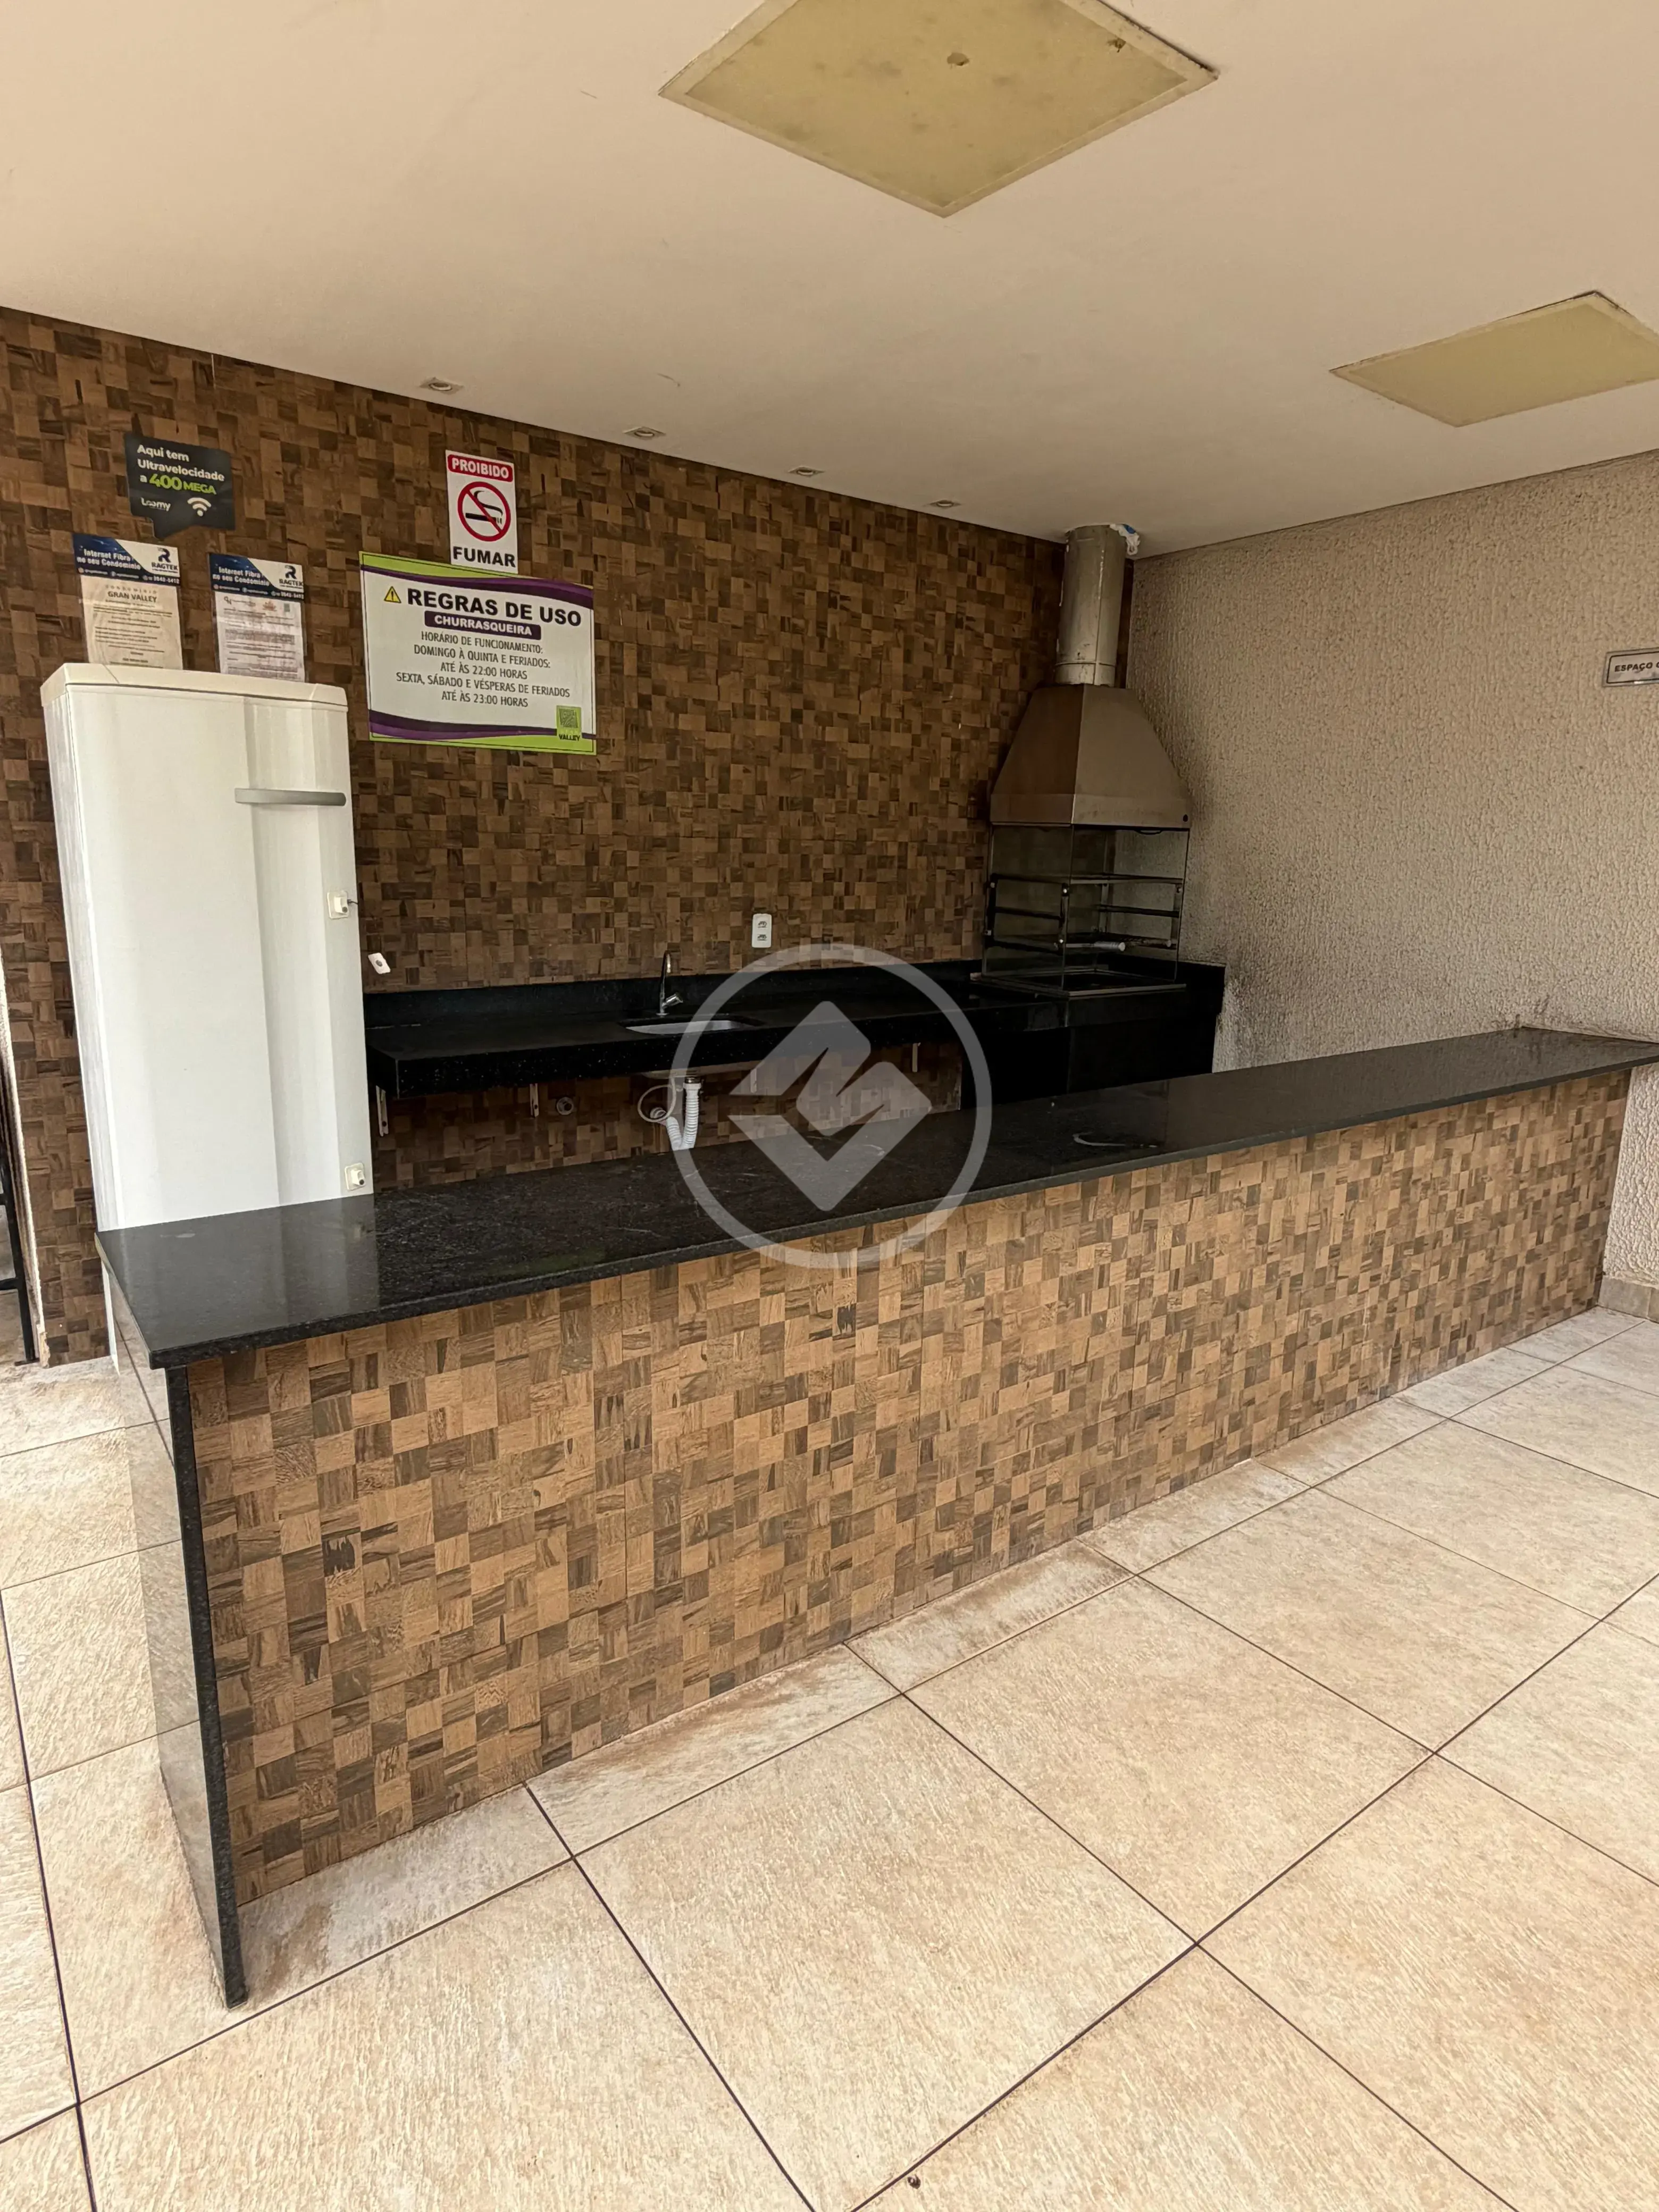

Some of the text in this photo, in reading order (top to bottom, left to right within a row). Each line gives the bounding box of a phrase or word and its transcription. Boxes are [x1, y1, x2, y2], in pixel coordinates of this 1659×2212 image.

[137, 445, 189, 462] Aqui tem
[137, 458, 225, 481] Ultravelocidade
[452, 457, 509, 479] PROIBIDO
[149, 474, 182, 490] 400
[183, 481, 216, 495] MEGA
[84, 548, 111, 559] Internet
[453, 546, 516, 568] FUMAR
[219, 566, 244, 576] Internet
[107, 591, 157, 602] GRAN VALLEY
[407, 588, 581, 626] REGRAS DE USO
[434, 615, 532, 635] CHURRASQUEIRA
[421, 630, 543, 654] HORÁRIO DE FUNCIONAMENTO:
[414, 644, 551, 668] DOMINGO À QUINTA E FERIADOS:
[440, 661, 527, 680] ATÉ ÀS 22:00 HORAS
[1614, 661, 1653, 672] ESPAÇO
[396, 672, 571, 698] SEXTA, SÁBADO E VÉSPERAS DE FERIADOS
[441, 689, 529, 708] ATÉ ÀS 23:00 HORAS
[558, 733, 581, 742] VALLEY
